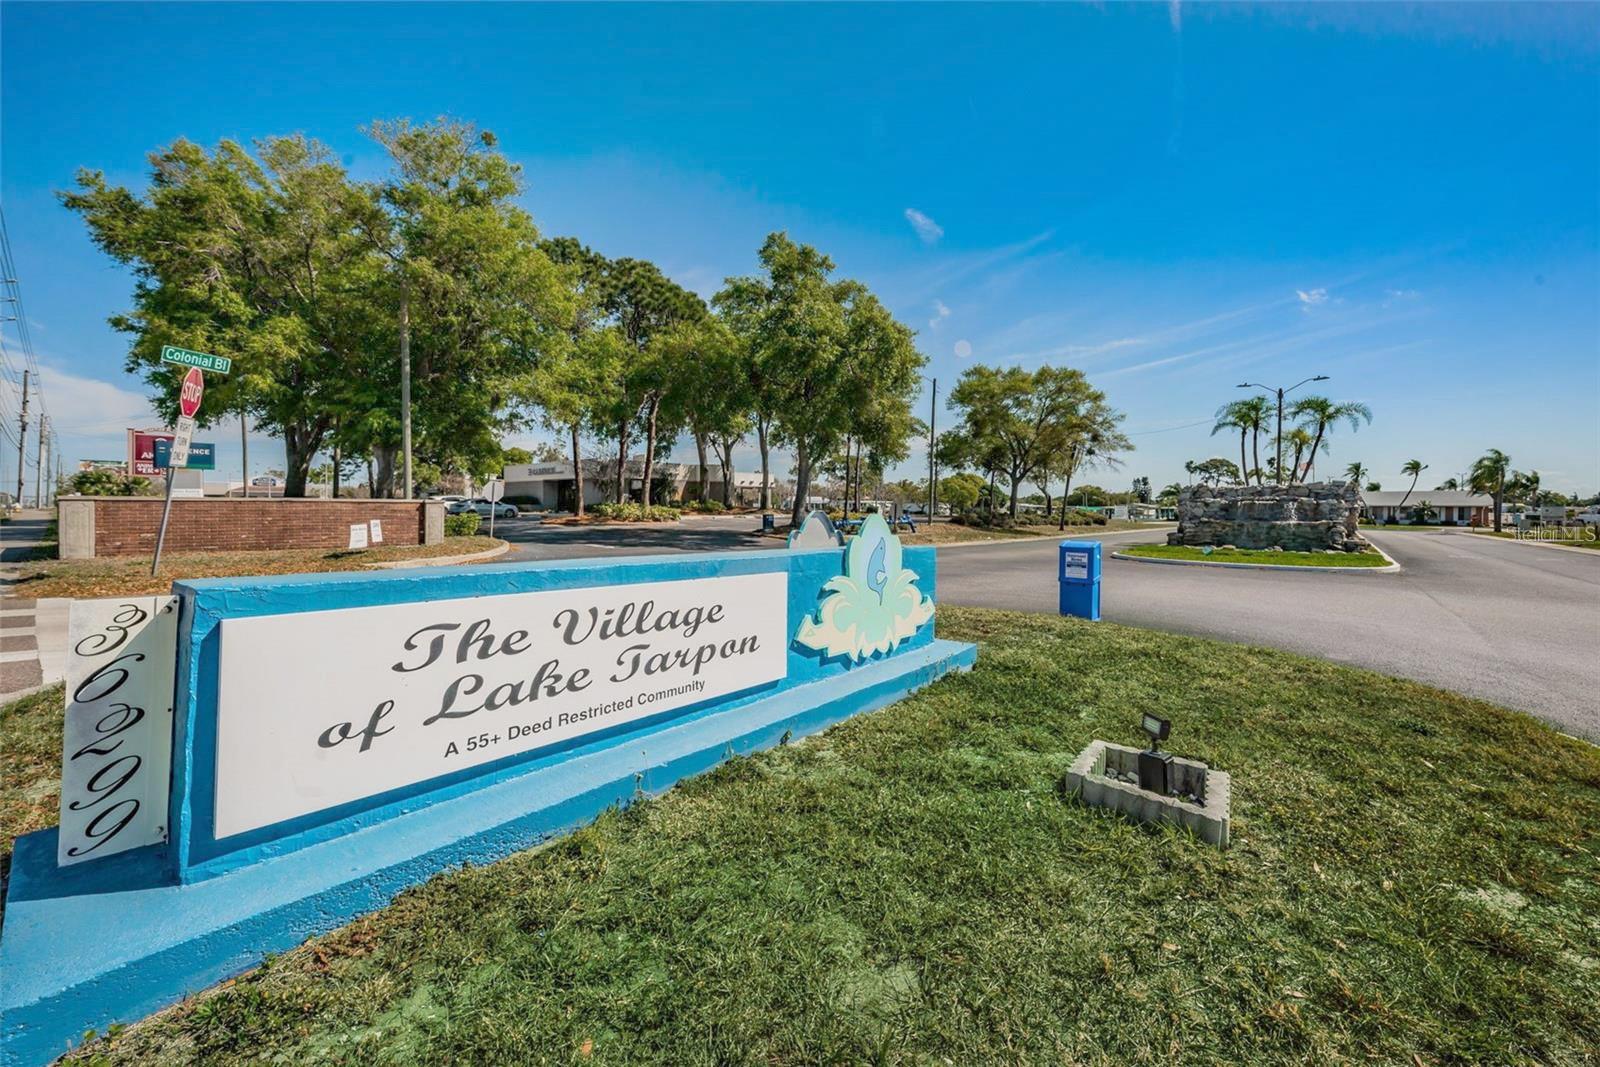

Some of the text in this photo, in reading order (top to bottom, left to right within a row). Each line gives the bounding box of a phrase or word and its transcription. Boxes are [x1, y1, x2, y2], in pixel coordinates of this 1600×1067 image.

[166, 349, 212, 367] Colonial
[183, 382, 201, 403] STOP
[391, 600, 726, 674] The Village
[66, 603, 149, 858] 36299
[317, 634, 761, 753] of Lake Tarpon
[444, 680, 706, 758] A 55+ Deed Restricted Community
